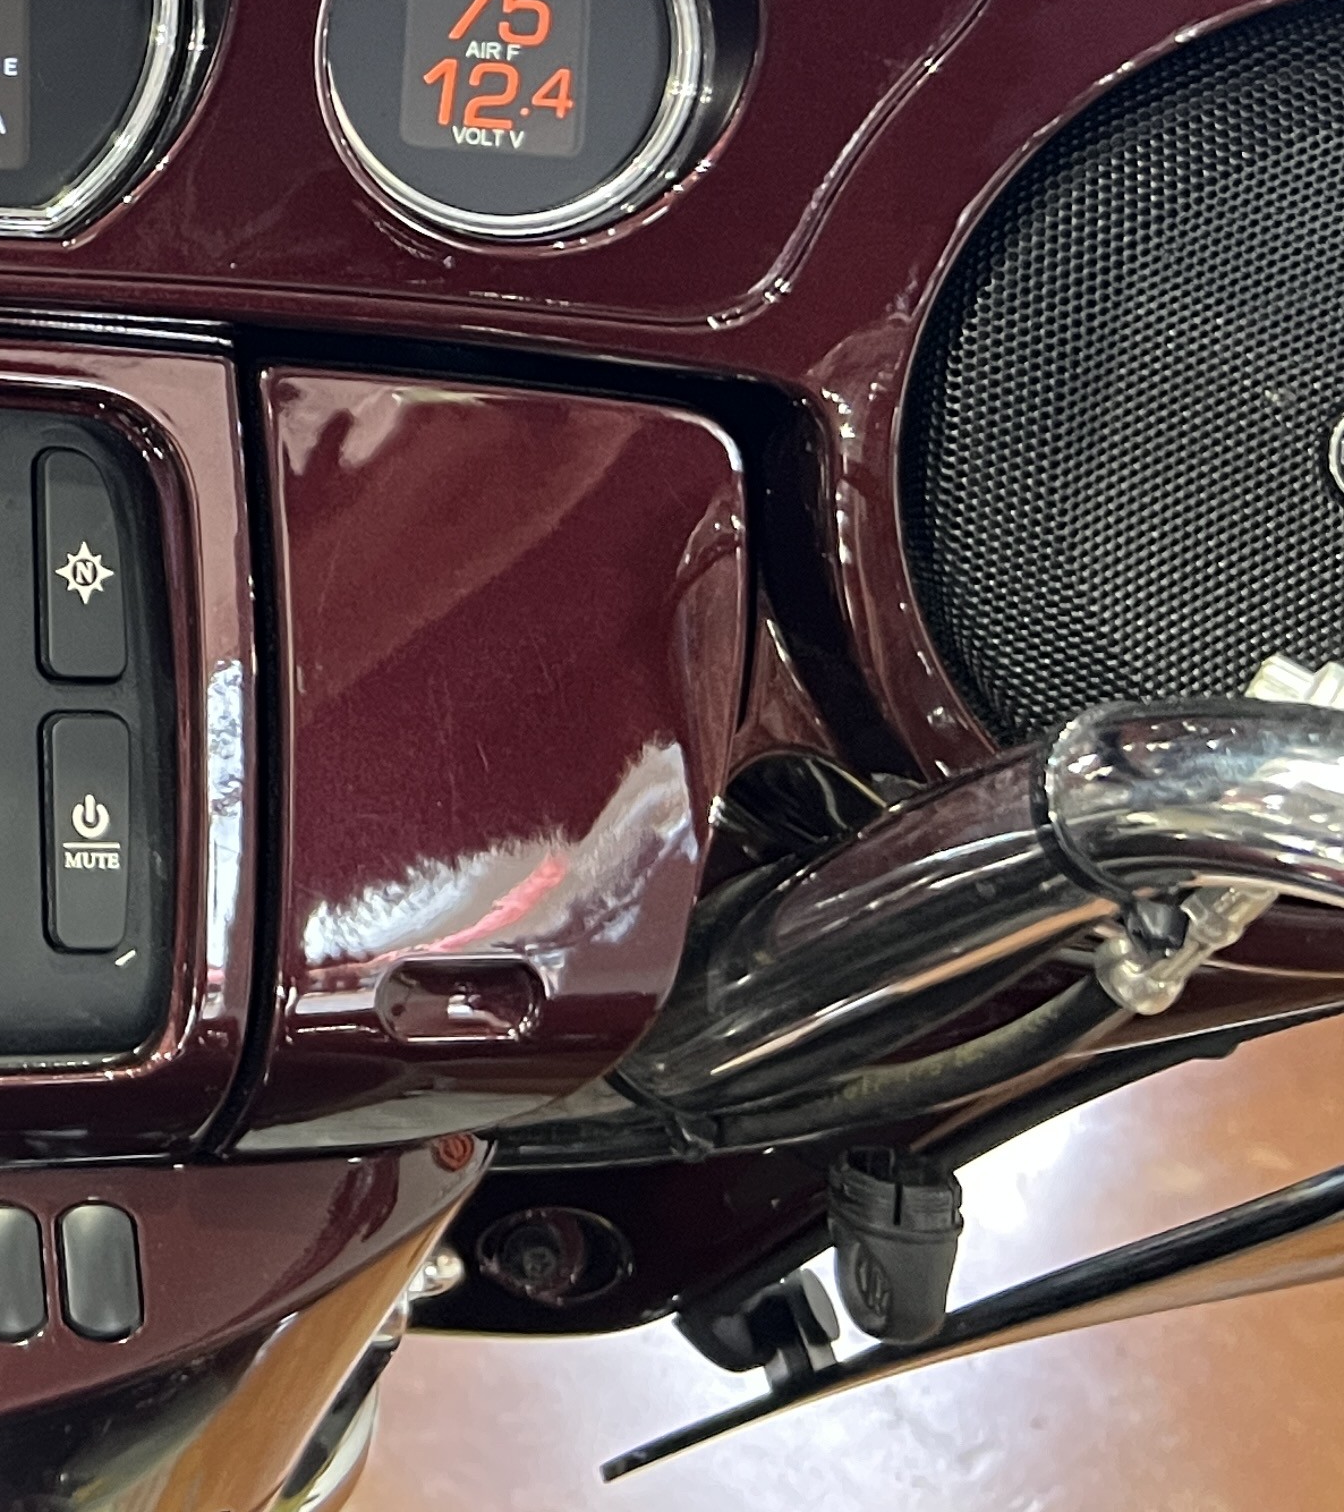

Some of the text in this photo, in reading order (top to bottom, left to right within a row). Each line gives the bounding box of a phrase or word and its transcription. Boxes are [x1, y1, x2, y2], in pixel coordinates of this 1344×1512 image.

[466, 41, 521, 61] AIR F
[3, 57, 18, 76] E
[423, 58, 574, 130] 12.4
[452, 126, 525, 149] VOLT V
[64, 852, 120, 869] MUTE
